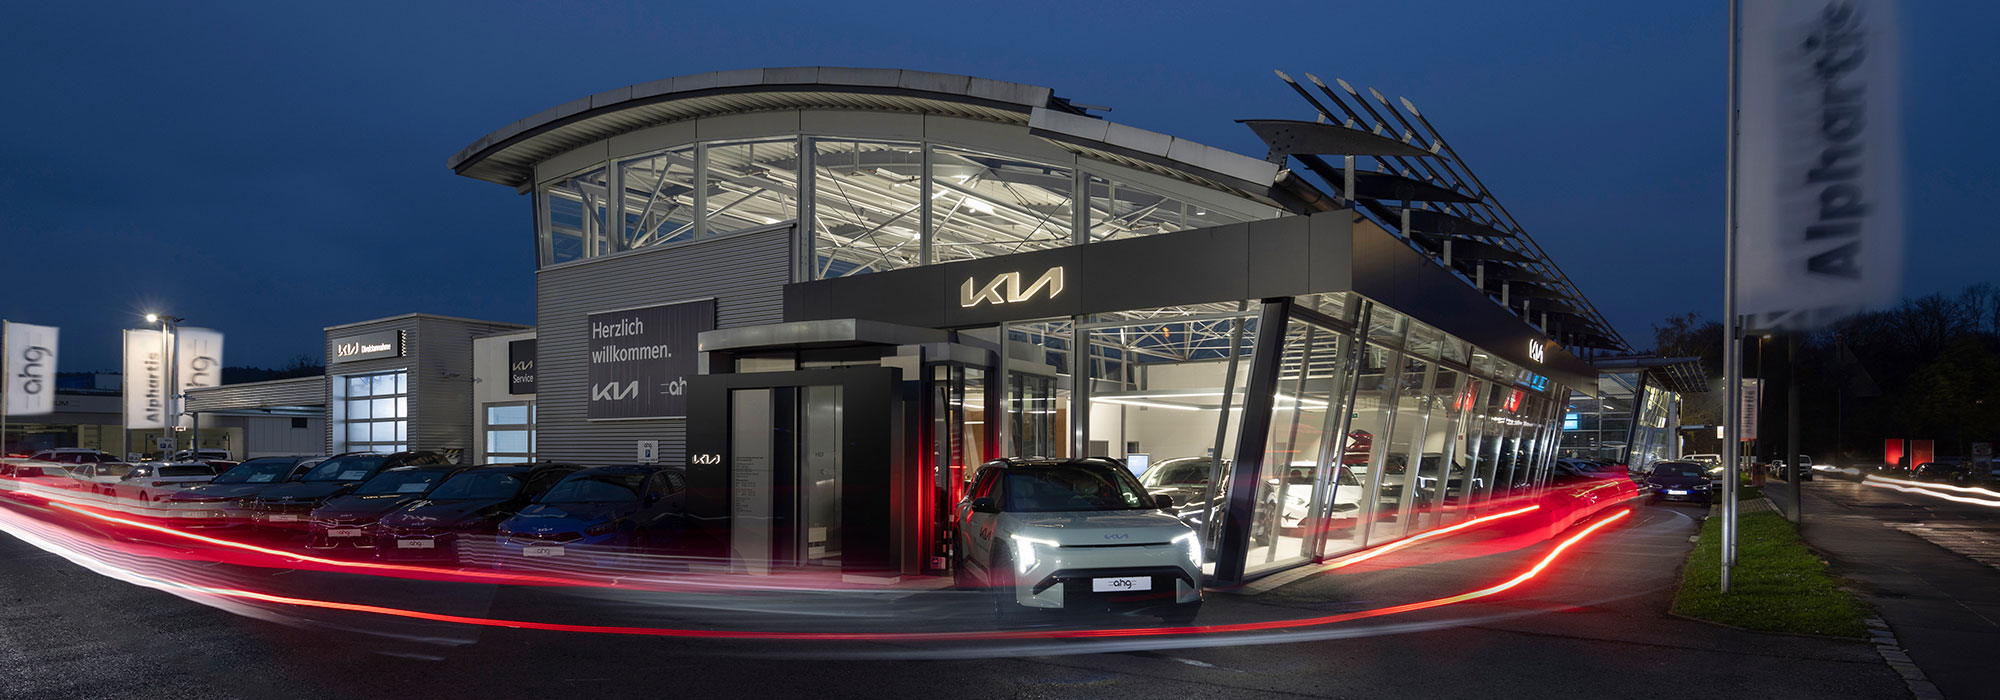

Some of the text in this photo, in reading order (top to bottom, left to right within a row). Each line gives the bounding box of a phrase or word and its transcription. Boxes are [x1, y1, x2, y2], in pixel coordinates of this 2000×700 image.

[960, 266, 1063, 307] KIA
[592, 317, 643, 339] Herzlich
[592, 344, 671, 363] willkommen.
[18, 346, 53, 394] ahg
[186, 356, 217, 386] hg
[513, 360, 533, 371] KIA
[145, 352, 162, 423] Alphartis
[513, 374, 534, 383] Service
[592, 376, 687, 401] KIA ah
[692, 454, 721, 464] KIA
[1113, 579, 1132, 589] ahg
